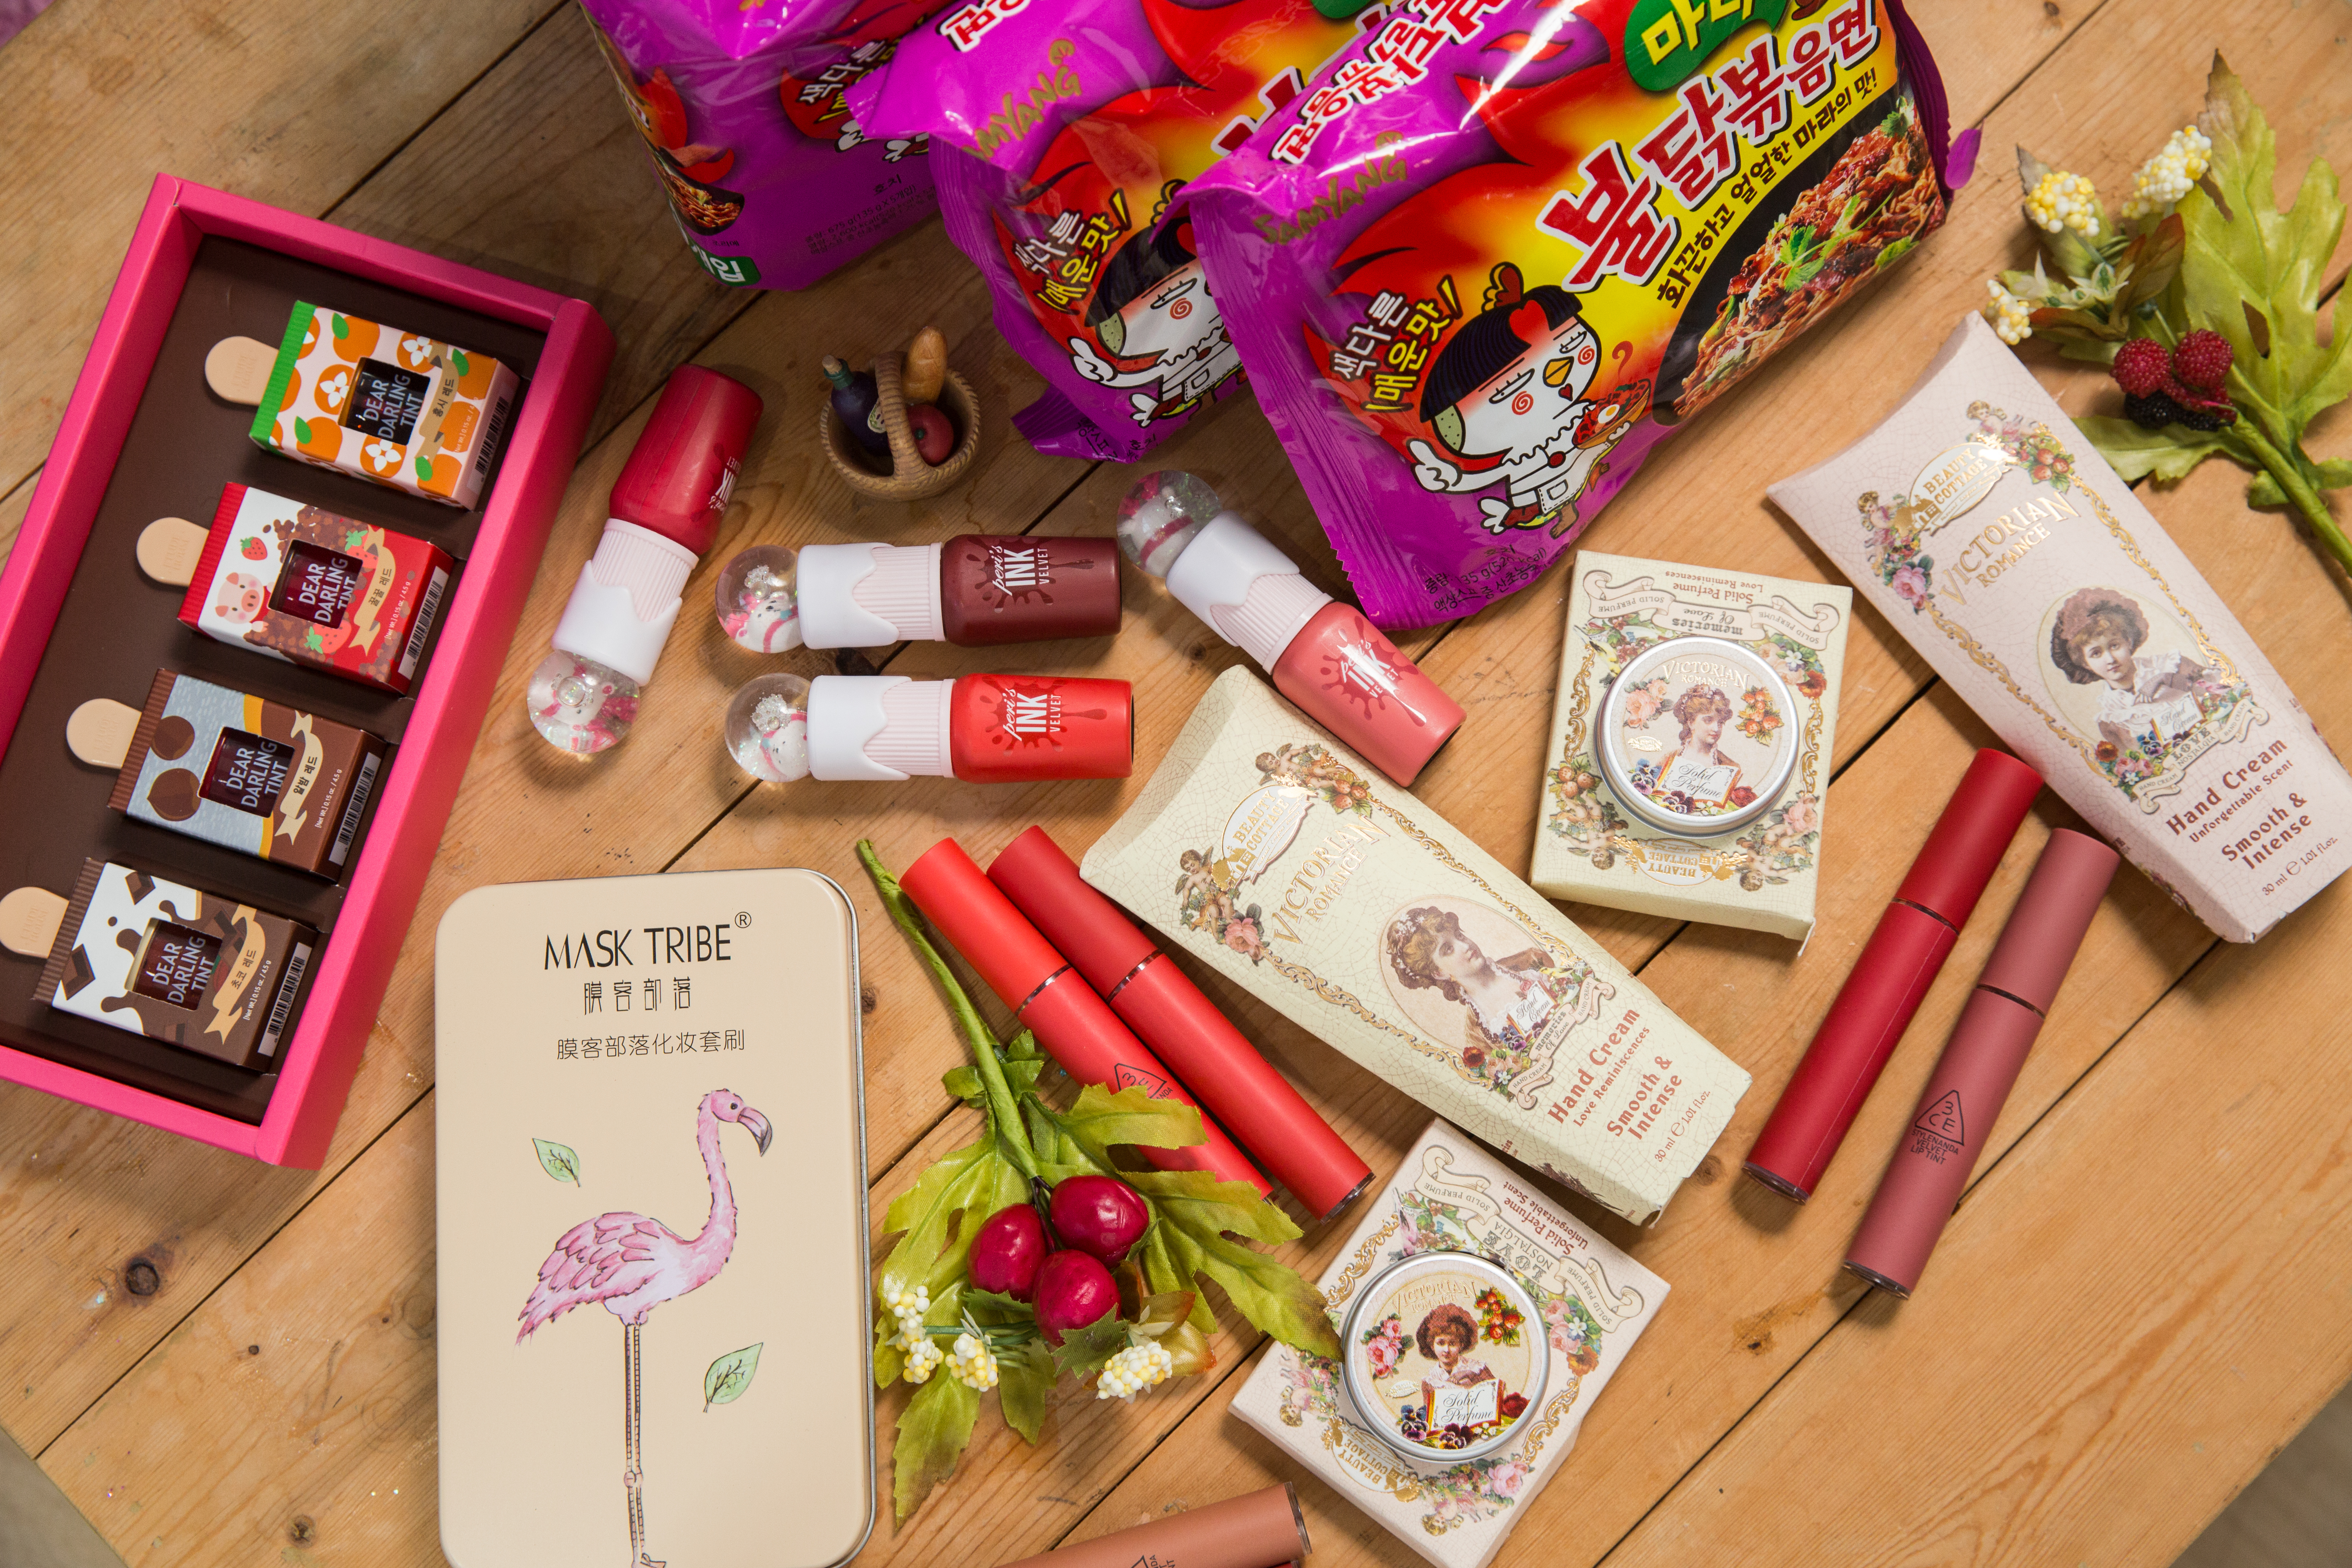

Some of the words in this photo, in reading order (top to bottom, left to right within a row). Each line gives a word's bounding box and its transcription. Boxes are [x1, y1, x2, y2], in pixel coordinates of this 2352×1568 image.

[1539, 1, 1876, 288] 불닭볶음면
[1254, 154, 1407, 245] SAMYANG
[1657, 209, 1735, 309] 화끈하고
[1731, 141, 1793, 205] 얼얼한
[1797, 95, 1852, 149] 마라의
[1855, 67, 1877, 99] 맛!
[1045, 215, 1119, 305] 매운맛
[1332, 291, 1409, 379] 색다른
[1374, 301, 1451, 402] 매운맛
[363, 379, 390, 421] DEAR
[378, 374, 411, 439] DARLING
[400, 393, 423, 426] TINT
[432, 399, 448, 417] 홍시
[442, 379, 454, 396] 레드
[1923, 448, 1977, 495] BEAUTY
[1934, 458, 1988, 505] COTTAGE
[1940, 490, 2081, 606] VICTORIAN
[1976, 522, 2051, 588] ROMANCE
[1004, 548, 1036, 587] INK
[1038, 548, 1049, 584] VELVET
[1666, 570, 1736, 589] Reminiscences
[299, 564, 326, 605] DEAR
[314, 558, 348, 623] DARLING
[337, 577, 356, 609] TINT
[368, 588, 385, 607] 꿀꿀
[380, 568, 392, 586] 레드
[392, 606, 401, 618] 0.15
[401, 585, 409, 595] 4.5
[1434, 588, 1481, 612] 액상스프
[1640, 596, 1664, 604] SOLID
[1673, 582, 1720, 600] Perfume
[1724, 590, 1753, 604] Solid
[1742, 581, 1763, 593] Love
[1598, 598, 1637, 612] PERFUME
[1683, 608, 1715, 620] Love
[1719, 613, 1735, 625] Of
[1673, 617, 1744, 636] memories
[1759, 611, 1796, 635] PERFUME
[1797, 630, 1820, 644] SOLID
[1341, 637, 1371, 683] pei's
[1348, 649, 1391, 691] INK
[1662, 660, 1749, 690] VICTORIAN
[1370, 668, 1399, 698] VEET
[1682, 673, 1727, 688] ROMANCE
[1016, 693, 1047, 732] INK
[1050, 694, 1061, 732] VELVET
[2160, 703, 2187, 728] Hand
[2172, 713, 2198, 733] Cream
[2224, 721, 2237, 737] HAND
[2234, 703, 2247, 722] CREAM
[2171, 726, 2211, 761] LOVE
[2177, 735, 2216, 767] NOSTALGIA
[226, 748, 255, 790] DEAR
[241, 741, 277, 808] DARLING
[265, 760, 288, 795] TINT
[294, 777, 310, 795] 알밤
[305, 756, 318, 774] 레드
[1679, 763, 1719, 782] Solid
[2138, 779, 2156, 792] HAND
[2157, 772, 2178, 786] CREAM
[322, 794, 332, 806] 0.15
[332, 773, 341, 783] 4.5
[1672, 775, 1722, 799] Perfume
[2165, 787, 2222, 837] Hand
[2222, 739, 2287, 793] Cream
[2189, 782, 2261, 844] Unforgettable
[2262, 759, 2294, 786] Scent
[1232, 790, 1276, 844] BEAUTY
[1246, 798, 1289, 851] COTTAGE
[2221, 806, 2289, 862] Smooth
[2289, 790, 2307, 808] &
[2242, 812, 2312, 870] Intense
[1647, 862, 1696, 878] BEAUTY
[1648, 851, 1699, 867] COTTAGE
[2262, 882, 2275, 896] 30
[2275, 873, 2287, 887] ml
[2300, 849, 2317, 866] 1.01
[2316, 837, 2338, 855] fl.oz.
[1272, 815, 1390, 944] VICTORIAN
[1305, 845, 1368, 922] ROMANCE
[152, 942, 182, 985] DEAR
[544, 929, 633, 970] MASK
[644, 924, 731, 964] TRIBE
[167, 935, 206, 1004] DARLING
[191, 957, 215, 991] TINT
[231, 971, 247, 989] 초코
[243, 950, 256, 968] 레드
[250, 985, 261, 998] 0.15
[260, 964, 270, 974] 4.5
[584, 976, 691, 1016] 膜客部落
[1516, 990, 1538, 1019] Hand
[1528, 999, 1550, 1022] Cream
[1578, 1000, 1588, 1016] HAND
[1583, 981, 1592, 1001] CREAM
[556, 1029, 745, 1060] 膜客部落化妆套刷
[1535, 1010, 1566, 1052] memories
[1545, 1038, 1557, 1051] Of
[1553, 1021, 1570, 1040] Love
[1513, 1076, 1528, 1089] HAND
[1528, 1063, 1547, 1078] CREAM
[1546, 1067, 1595, 1124] Hand
[1586, 1004, 1641, 1069] Cream
[1572, 1099, 1597, 1127] Love
[1591, 1025, 1652, 1100] Reminiscences
[1604, 1069, 1662, 1138] Smooth
[1652, 1051, 1673, 1072] &
[1627, 1071, 1684, 1140] Intense
[1653, 1148, 1667, 1163] 30
[1662, 1136, 1675, 1150] ml
[1680, 1106, 1697, 1124] 1.01
[1691, 1087, 1712, 1109] fl.oz.
[1911, 1128, 1959, 1155] STYLENANDA
[1911, 1145, 1924, 1154] LIP
[1926, 1150, 1946, 1165] TINT
[1917, 1138, 1947, 1156] VELVET
[1424, 1183, 1463, 1201] PERFUME
[1469, 1195, 1490, 1212] SOLID
[1503, 1181, 1532, 1205] Scent
[1504, 1198, 1546, 1235] Perfume
[1534, 1206, 1588, 1250] Unforgettable
[1483, 1231, 1547, 1282] LOVE
[1494, 1221, 1553, 1270] NOSTALGIA
[1546, 1231, 1572, 1256] Solid
[1389, 1280, 1477, 1313] VICTORIAN
[1568, 1267, 1594, 1301] PERFUME
[1412, 1294, 1457, 1312] ROMANCE
[1593, 1301, 1613, 1325] SOLID
[1441, 1403, 1493, 1423] Perfume
[1443, 1390, 1478, 1407] Solid
[1339, 1449, 1380, 1484] BEAUTY
[1343, 1440, 1393, 1478] COTTAGE
